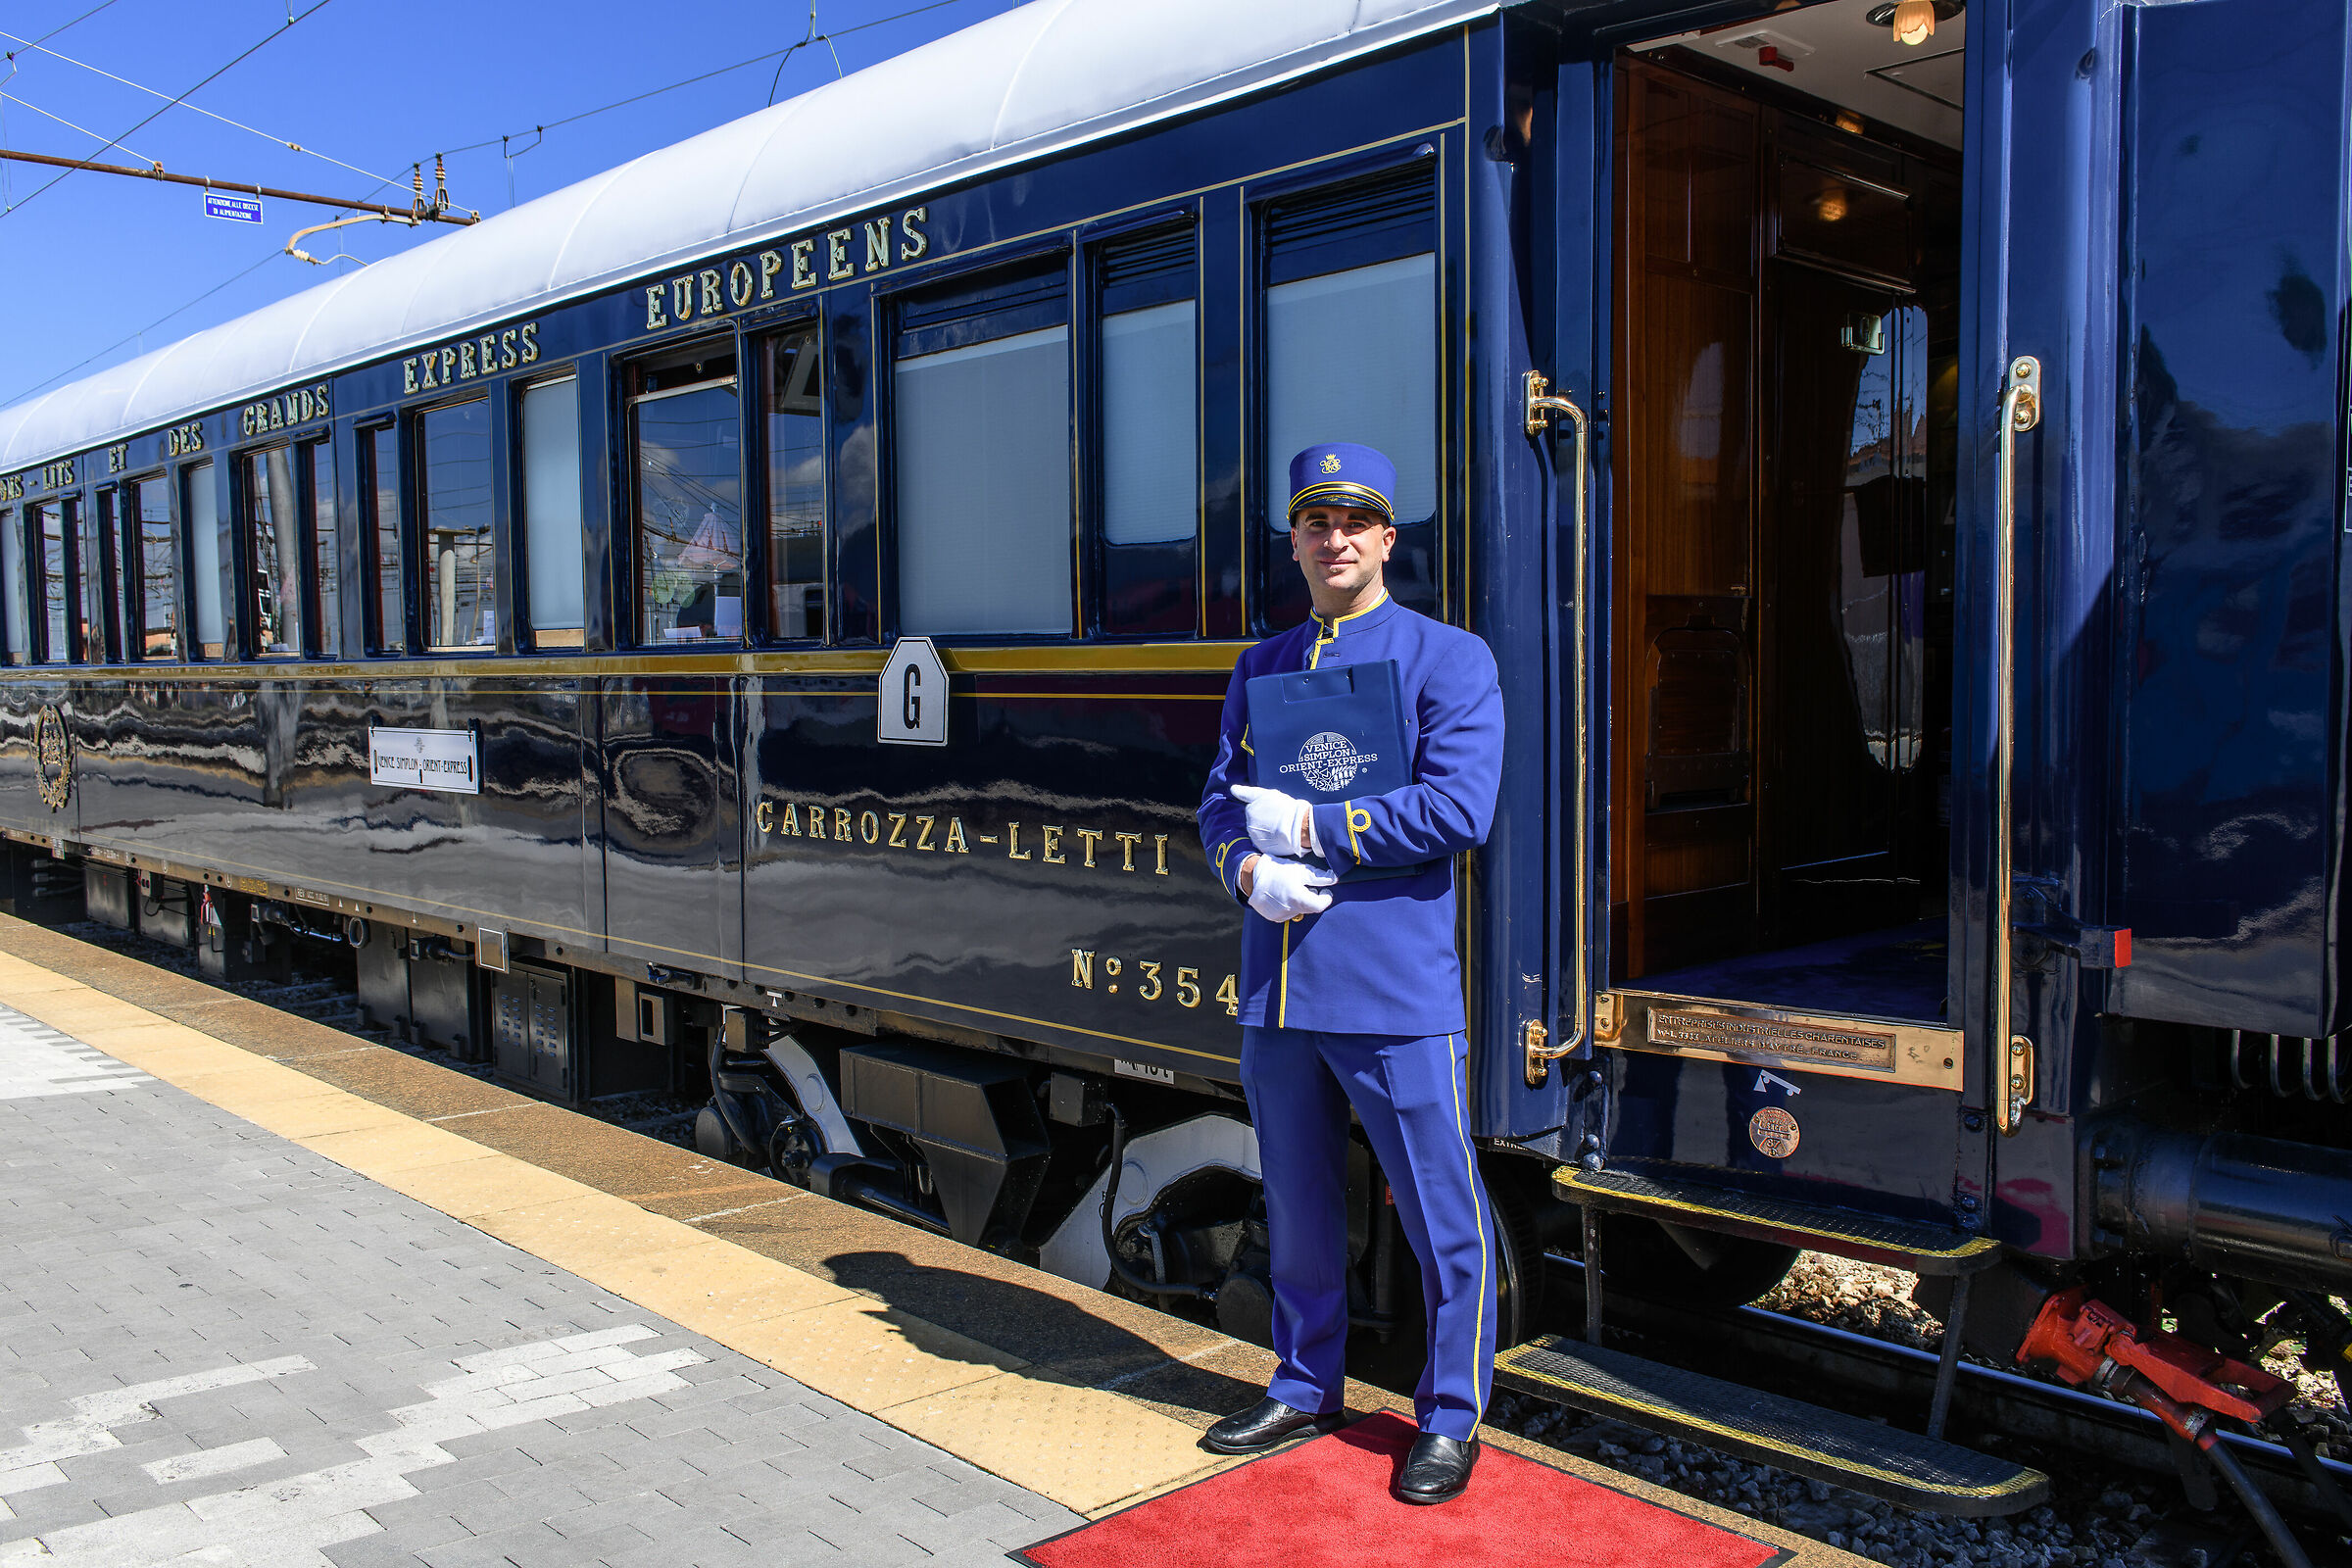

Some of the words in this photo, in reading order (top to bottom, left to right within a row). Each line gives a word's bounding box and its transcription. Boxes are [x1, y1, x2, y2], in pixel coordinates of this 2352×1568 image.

[42, 460, 74, 490] LITS
[108, 443, 128, 473] ET
[168, 421, 204, 457] DES
[242, 383, 329, 436] GRANDS
[403, 321, 539, 394] EXPRESS
[645, 206, 928, 330] EUROPEENS
[902, 662, 921, 730] G
[1304, 749, 1350, 761] SIMPLON
[1305, 741, 1347, 753] VENICE
[378, 756, 395, 768] VENICE
[397, 758, 417, 770] SIMPLON
[422, 759, 468, 774] ORIENT-EXPRESS
[1279, 753, 1379, 774] ORIENT-EXPRESS
[1138, 960, 1239, 1016] 354
[1657, 1014, 1726, 1031] ENTREPRISES
[1726, 1022, 1804, 1039] INDUSTRIELLES
[1805, 1032, 1886, 1050] CHARENTAISES
[1811, 1047, 1858, 1060] FRANCE
